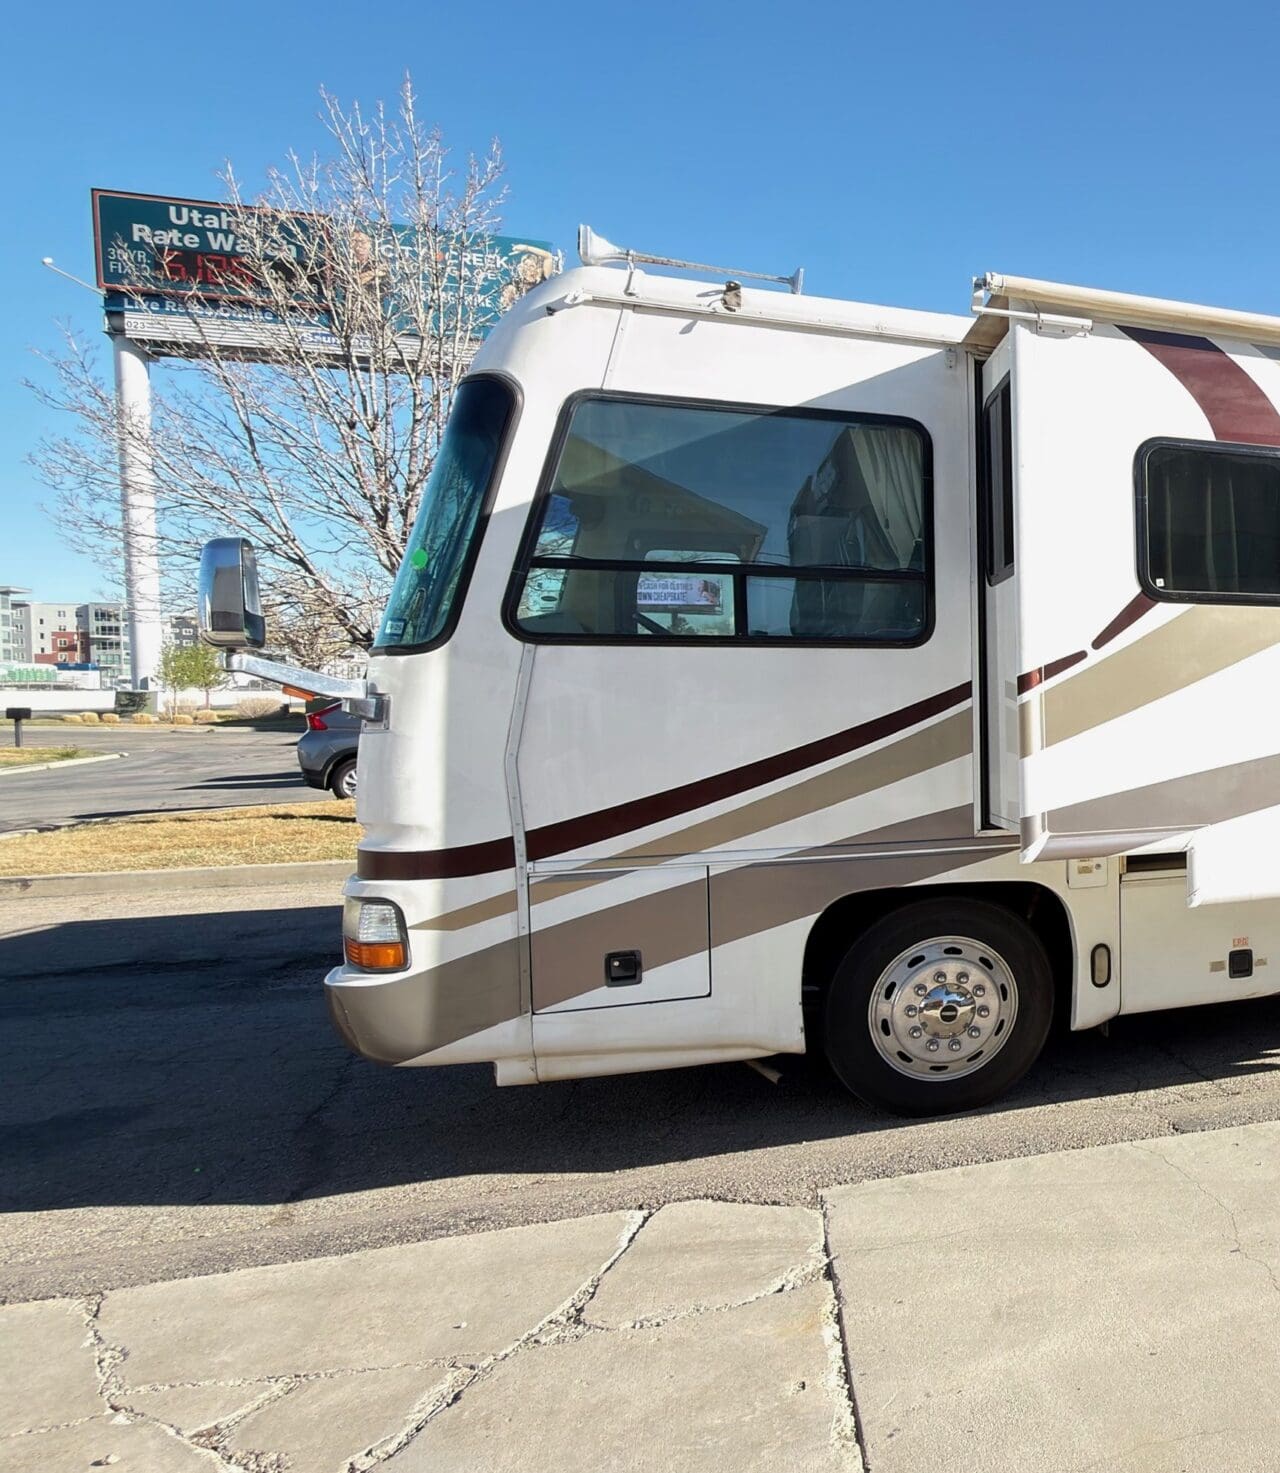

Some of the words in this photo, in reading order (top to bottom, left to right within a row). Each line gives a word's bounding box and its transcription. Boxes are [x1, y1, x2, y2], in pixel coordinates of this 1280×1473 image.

[132, 223, 200, 248] Rate
[206, 231, 297, 258] Wach
[380, 244, 431, 262] CTY
[445, 249, 509, 269] CREEK
[109, 261, 150, 277] FIXD
[126, 321, 145, 329] 023
